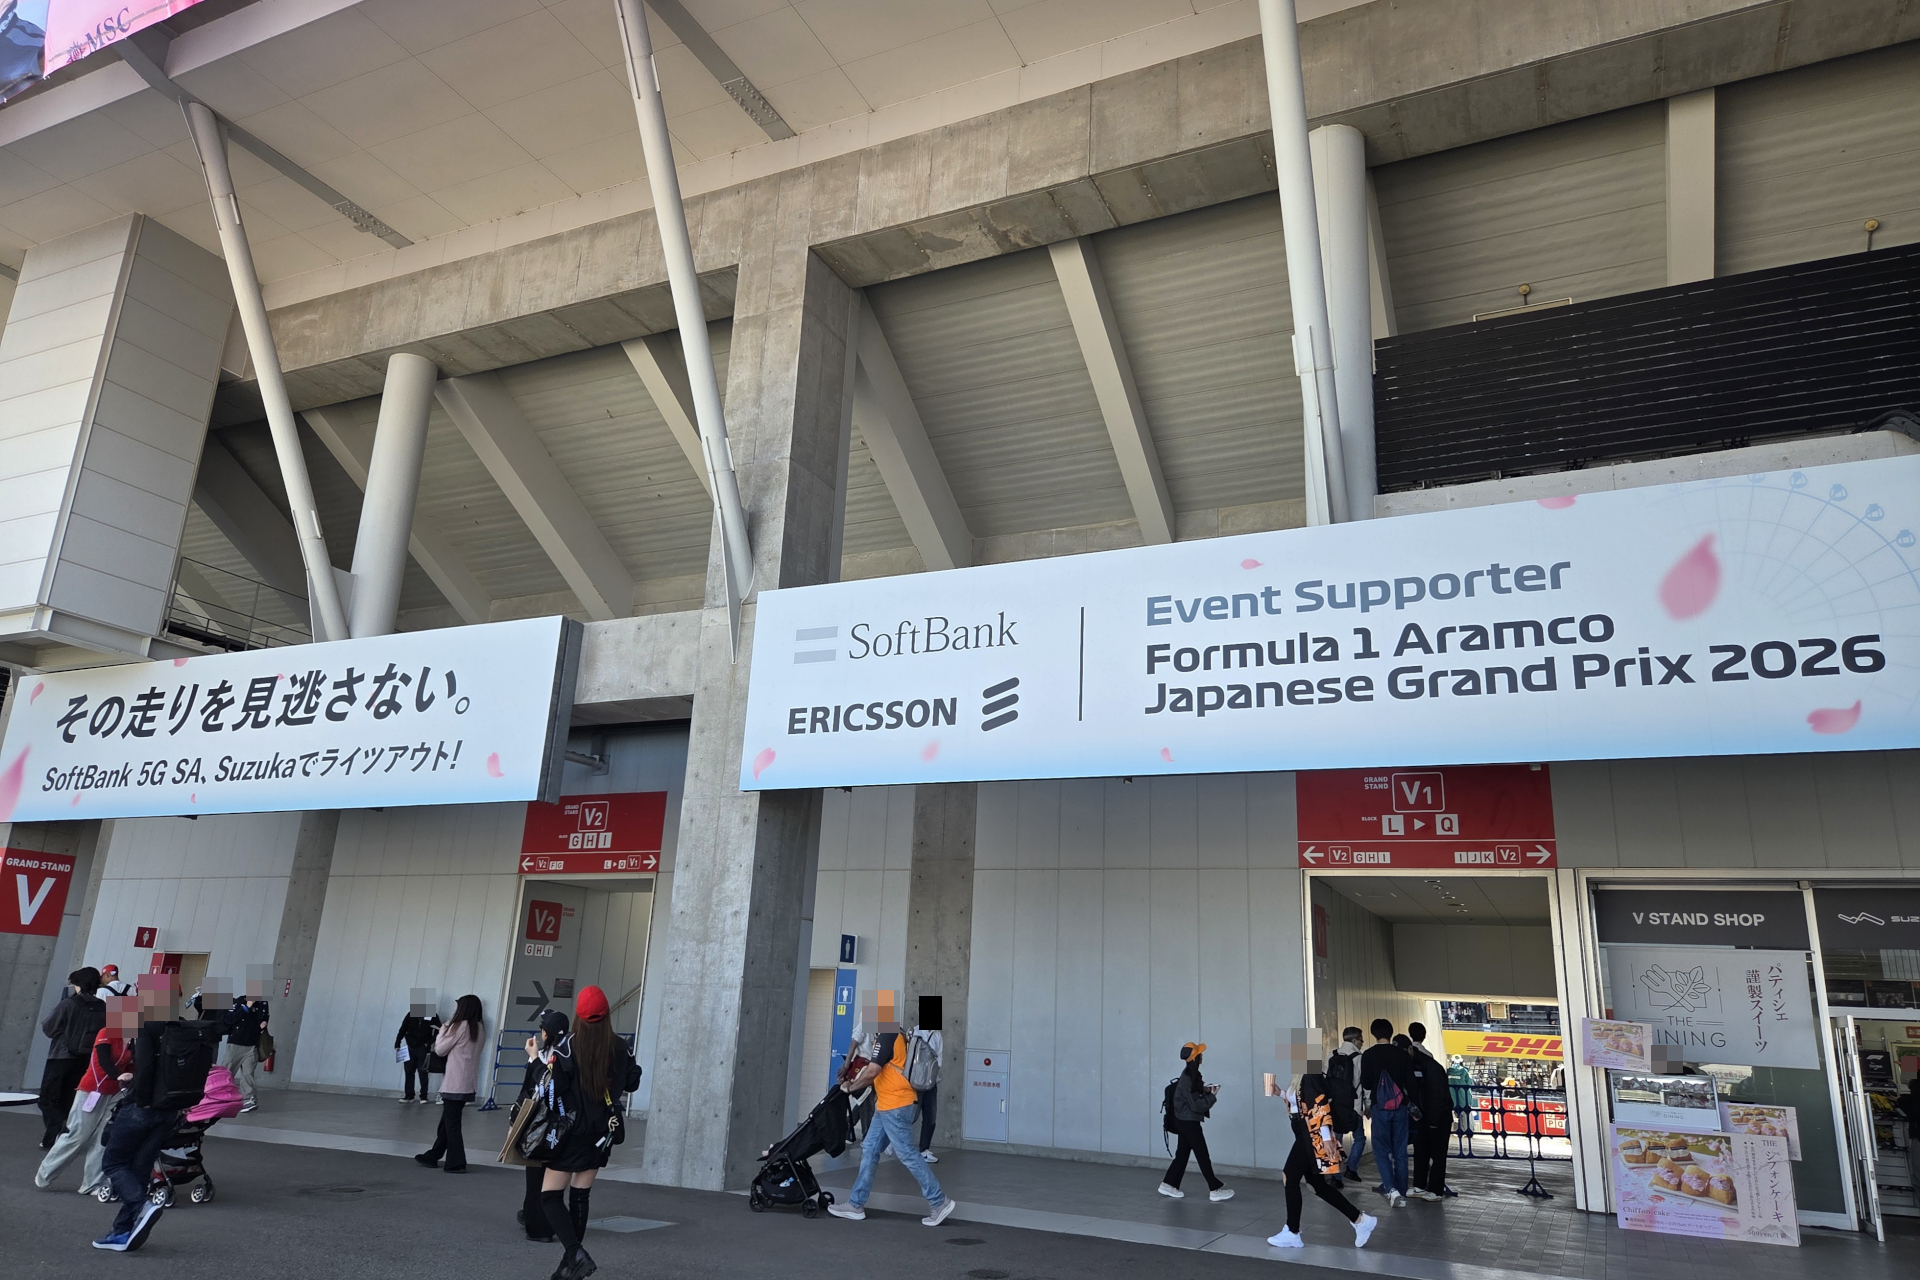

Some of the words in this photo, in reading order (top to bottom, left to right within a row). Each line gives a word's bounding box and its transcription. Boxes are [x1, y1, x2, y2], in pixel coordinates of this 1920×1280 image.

[84, 6, 132, 53] MSC
[1146, 586, 1282, 626] Event
[1295, 561, 1571, 613] Supporter
[848, 611, 1019, 660] SoftBank
[1146, 632, 1340, 675] Formula
[1353, 627, 1380, 659] 1
[1393, 613, 1615, 657] Aramco
[1145, 675, 1374, 718] Japanese
[1387, 656, 1557, 700] Grand
[1572, 646, 1696, 690] Prix
[1708, 634, 1886, 682] 2026
[56, 662, 470, 744] その走りを見逃さない。
[787, 697, 957, 735] ERICSSON
[42, 761, 133, 792] SoftBank
[136, 760, 168, 786] 5G
[1400, 781, 1432, 805] V1
[584, 808, 603, 826] V2
[6, 858, 40, 868] GRAND
[40, 862, 71, 872] STAND
[538, 860, 546, 868] V2
[1332, 850, 1347, 861] V2
[1500, 850, 1516, 861] V2
[16, 874, 56, 926] V
[534, 908, 556, 934] V2
[1632, 912, 1644, 925] V
[1649, 912, 1709, 926] STAND
[1713, 913, 1765, 927] SHOP
[1666, 1015, 1693, 1028] THE
[1746, 969, 1768, 1053] 謹製スイーツ
[1657, 1029, 1726, 1048] INING
[1766, 1151, 1784, 1223] シフォンケーキ
[1622, 1206, 1651, 1214] Chiffon
